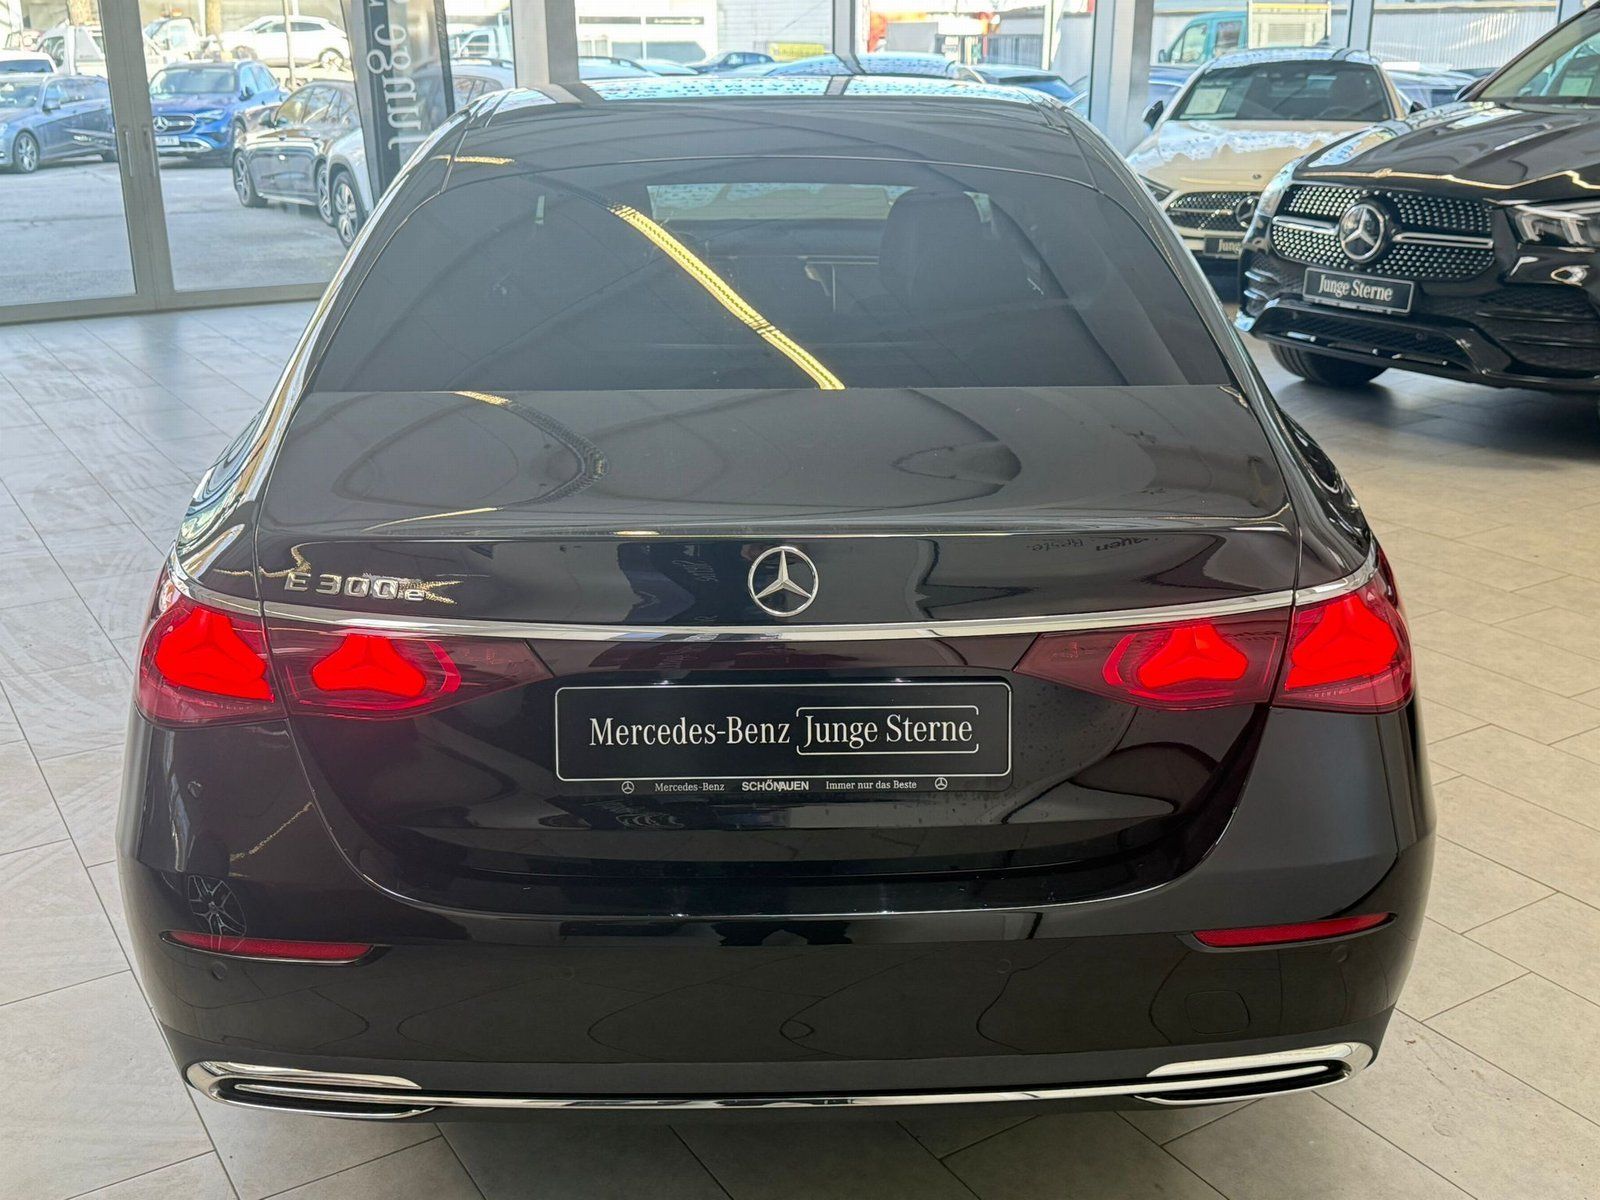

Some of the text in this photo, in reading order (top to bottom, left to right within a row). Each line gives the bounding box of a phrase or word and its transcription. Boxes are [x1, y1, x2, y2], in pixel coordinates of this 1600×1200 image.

[1217, 239, 1242, 255] Jung
[1318, 274, 1394, 302] Junge Sterne
[284, 571, 311, 592] E
[589, 713, 973, 749] Mercedes-Benz Junge Sterne
[654, 779, 918, 793] Mercedes-Benz SCHÖNAUEN Immer nur das Beste
